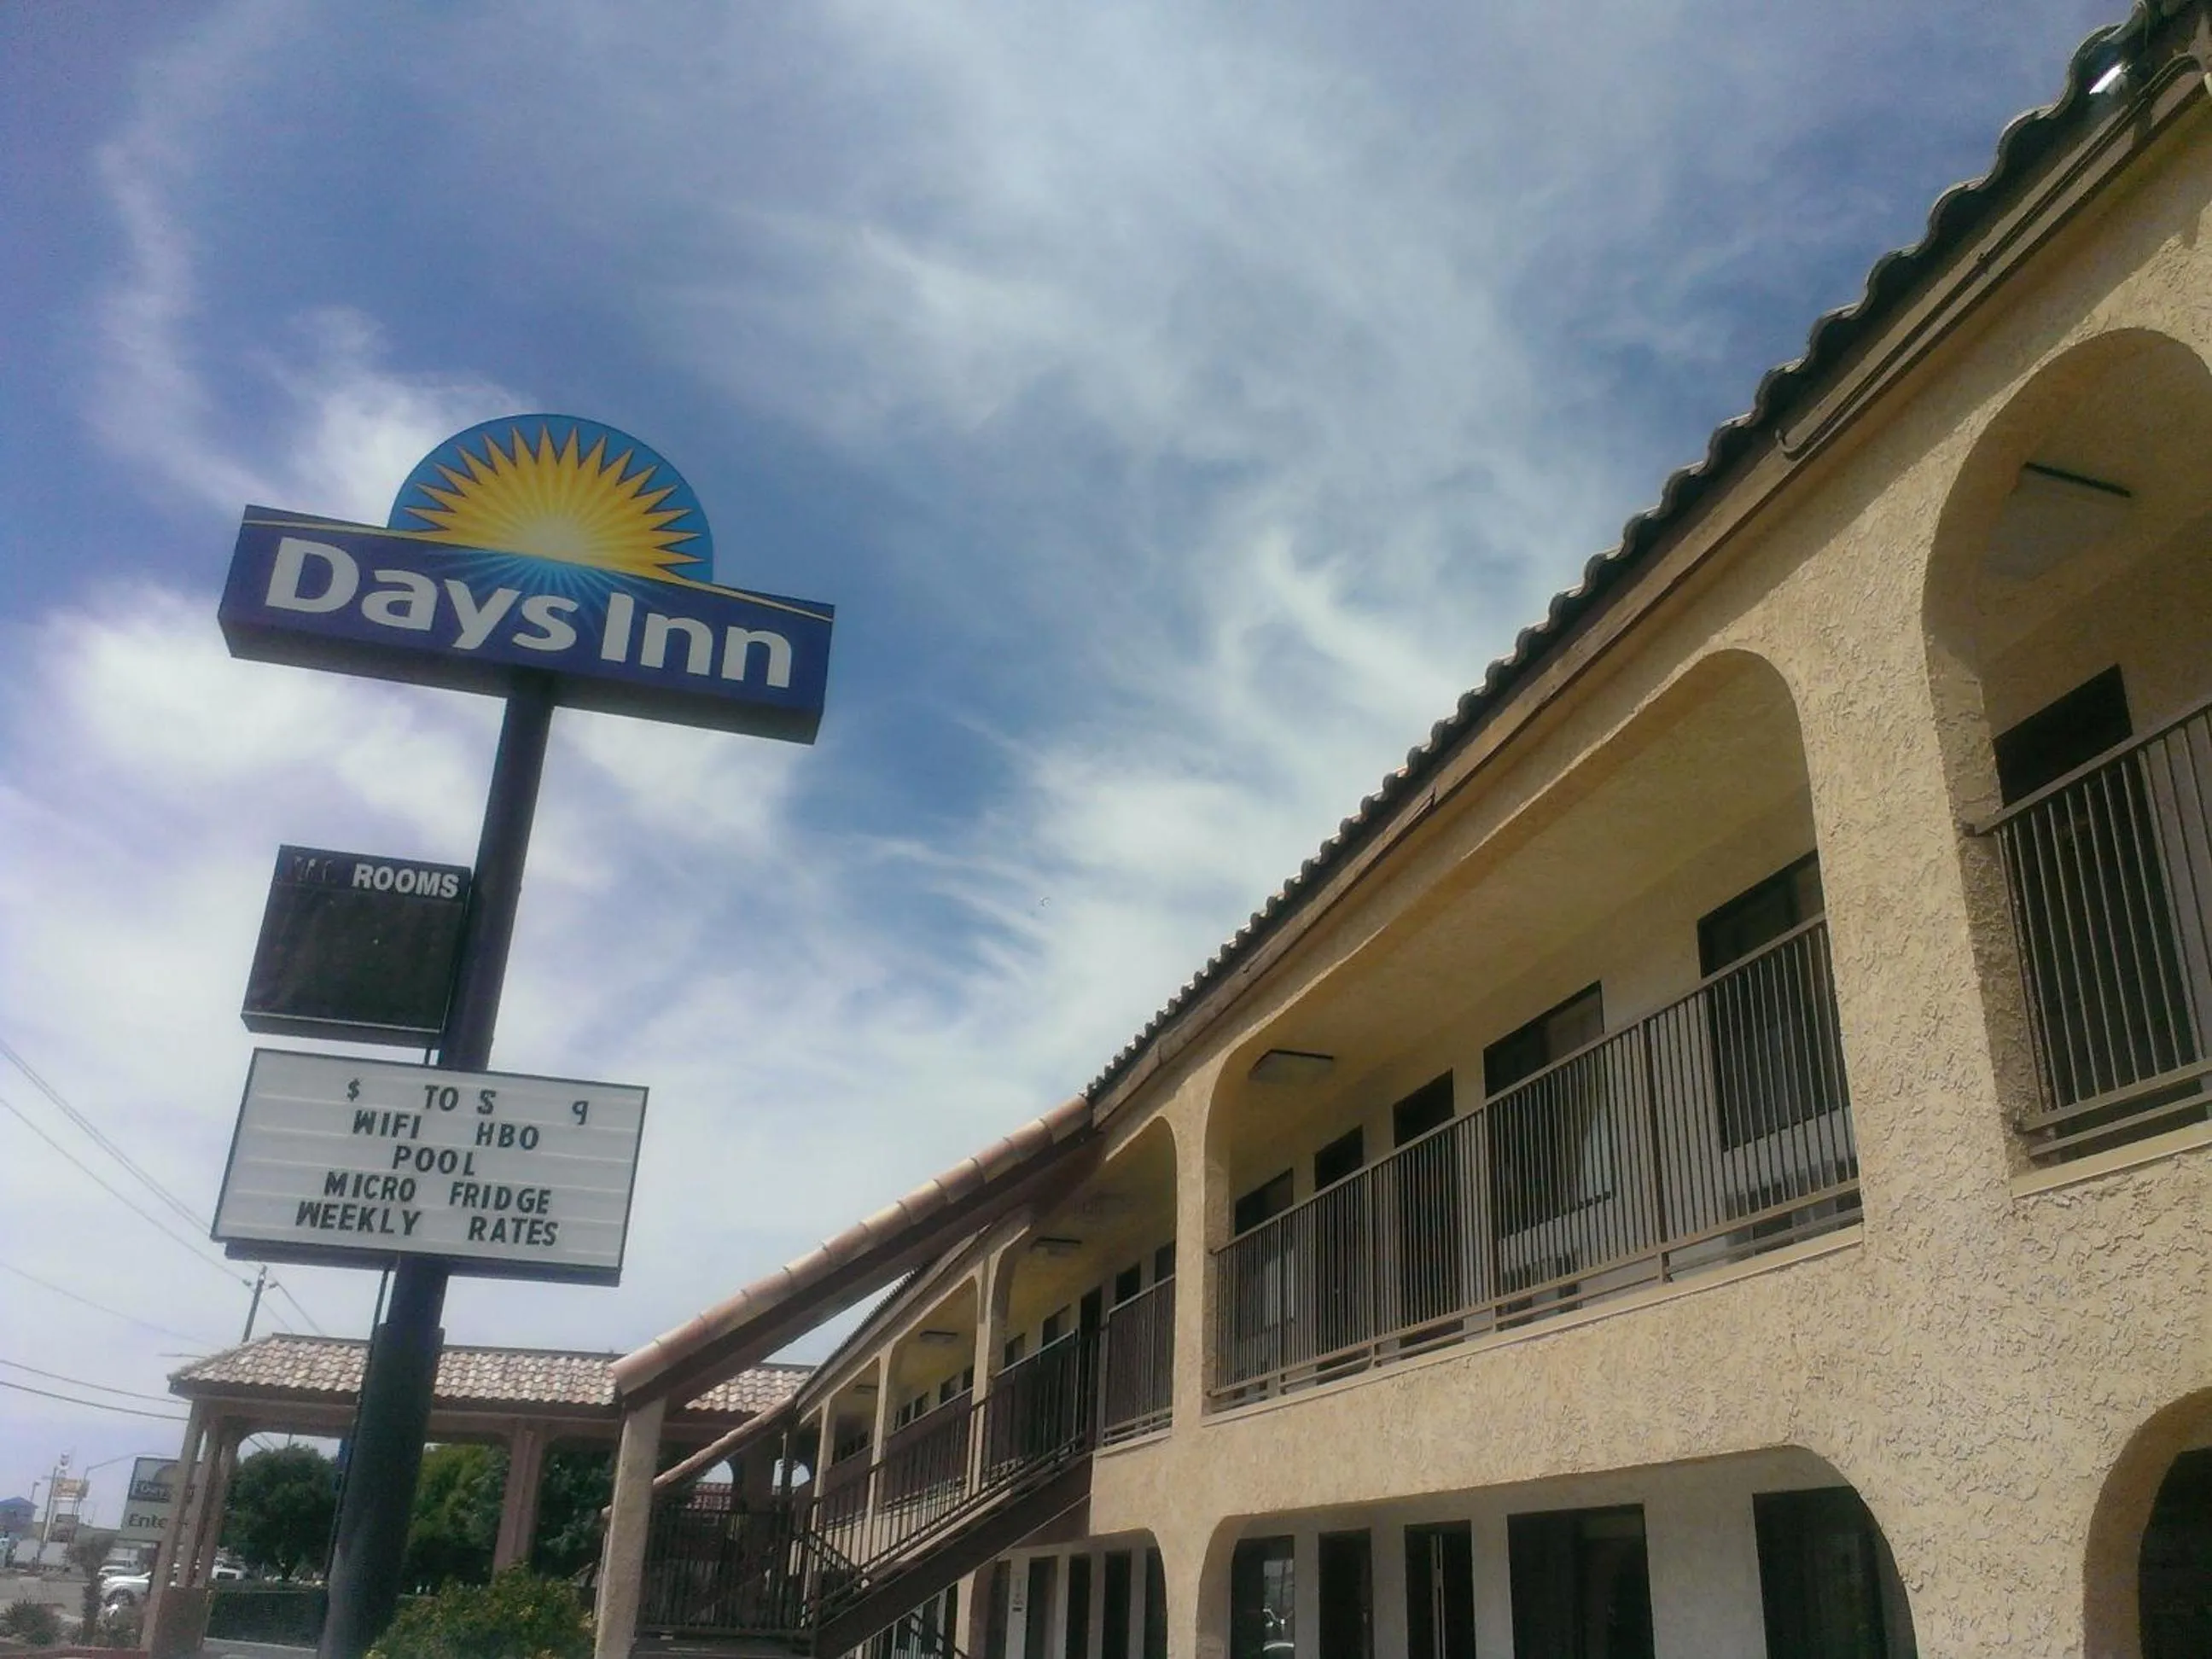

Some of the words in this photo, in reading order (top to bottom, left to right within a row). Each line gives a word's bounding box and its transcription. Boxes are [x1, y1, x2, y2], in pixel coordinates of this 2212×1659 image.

[265, 536, 578, 653] Days
[600, 591, 793, 689] Inn
[352, 862, 460, 898] ROOMS
[424, 1085, 459, 1112] TO
[352, 1109, 422, 1139] WIFI
[475, 1121, 540, 1150] HBO
[392, 1145, 475, 1177] POOL
[323, 1172, 416, 1202] MICRO
[449, 1181, 552, 1215] FRIDGE
[295, 1202, 422, 1236] WEEKLY
[468, 1215, 559, 1247] RATES
